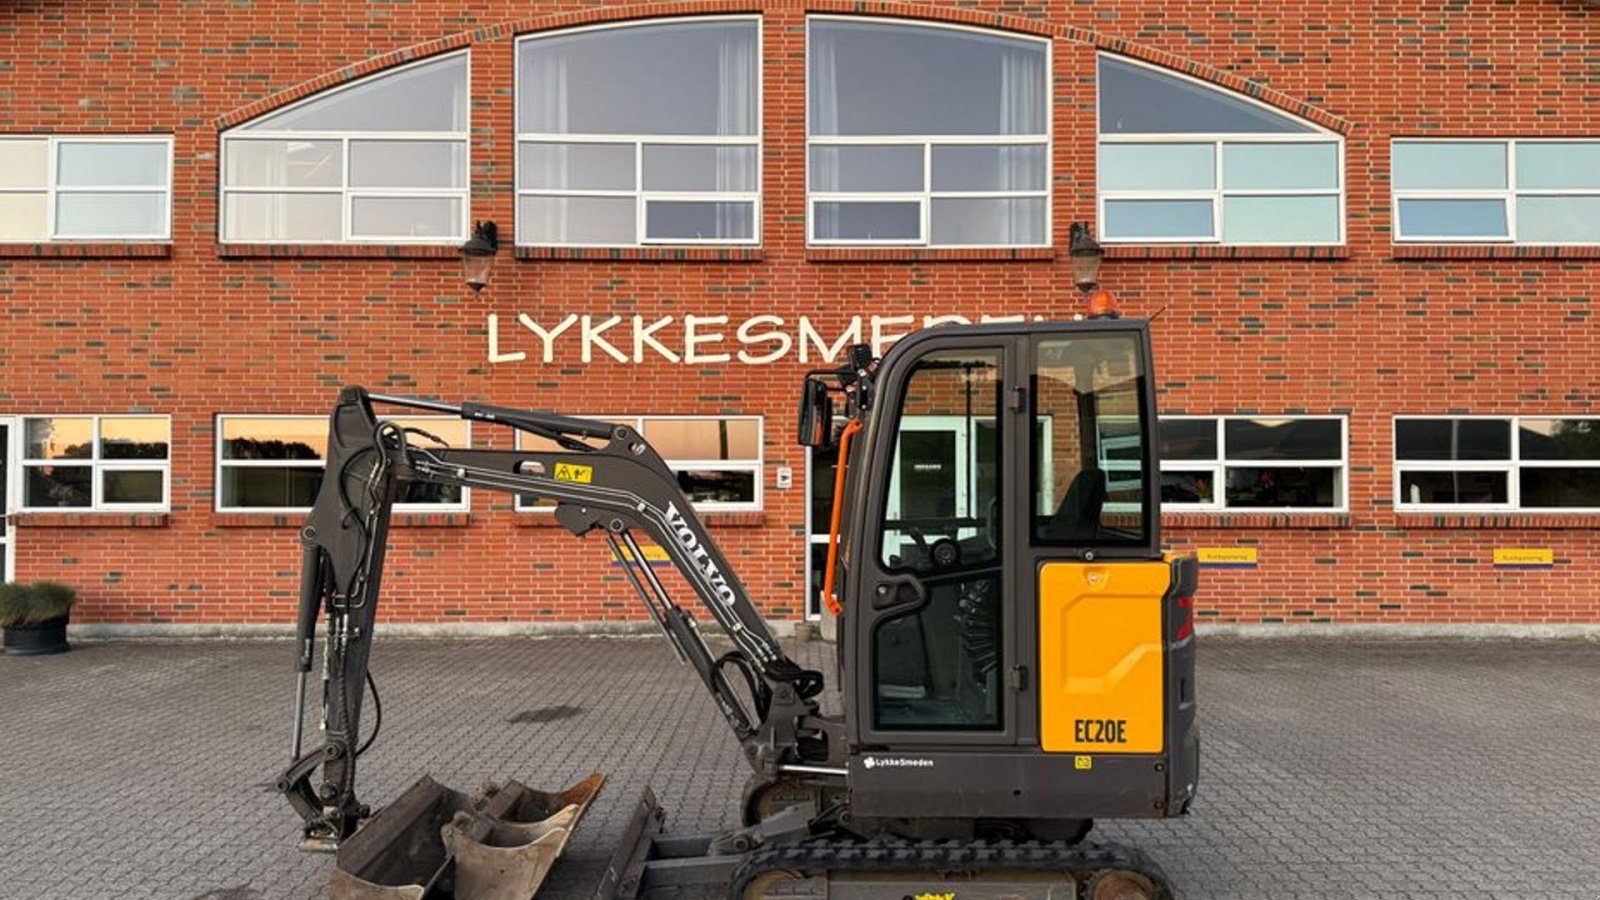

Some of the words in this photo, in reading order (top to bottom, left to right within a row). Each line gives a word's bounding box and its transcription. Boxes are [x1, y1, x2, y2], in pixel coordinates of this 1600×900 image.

[487, 312, 1083, 364] LYKKESME
[665, 500, 736, 607] VOLVO
[1074, 719, 1127, 743] EC20E
